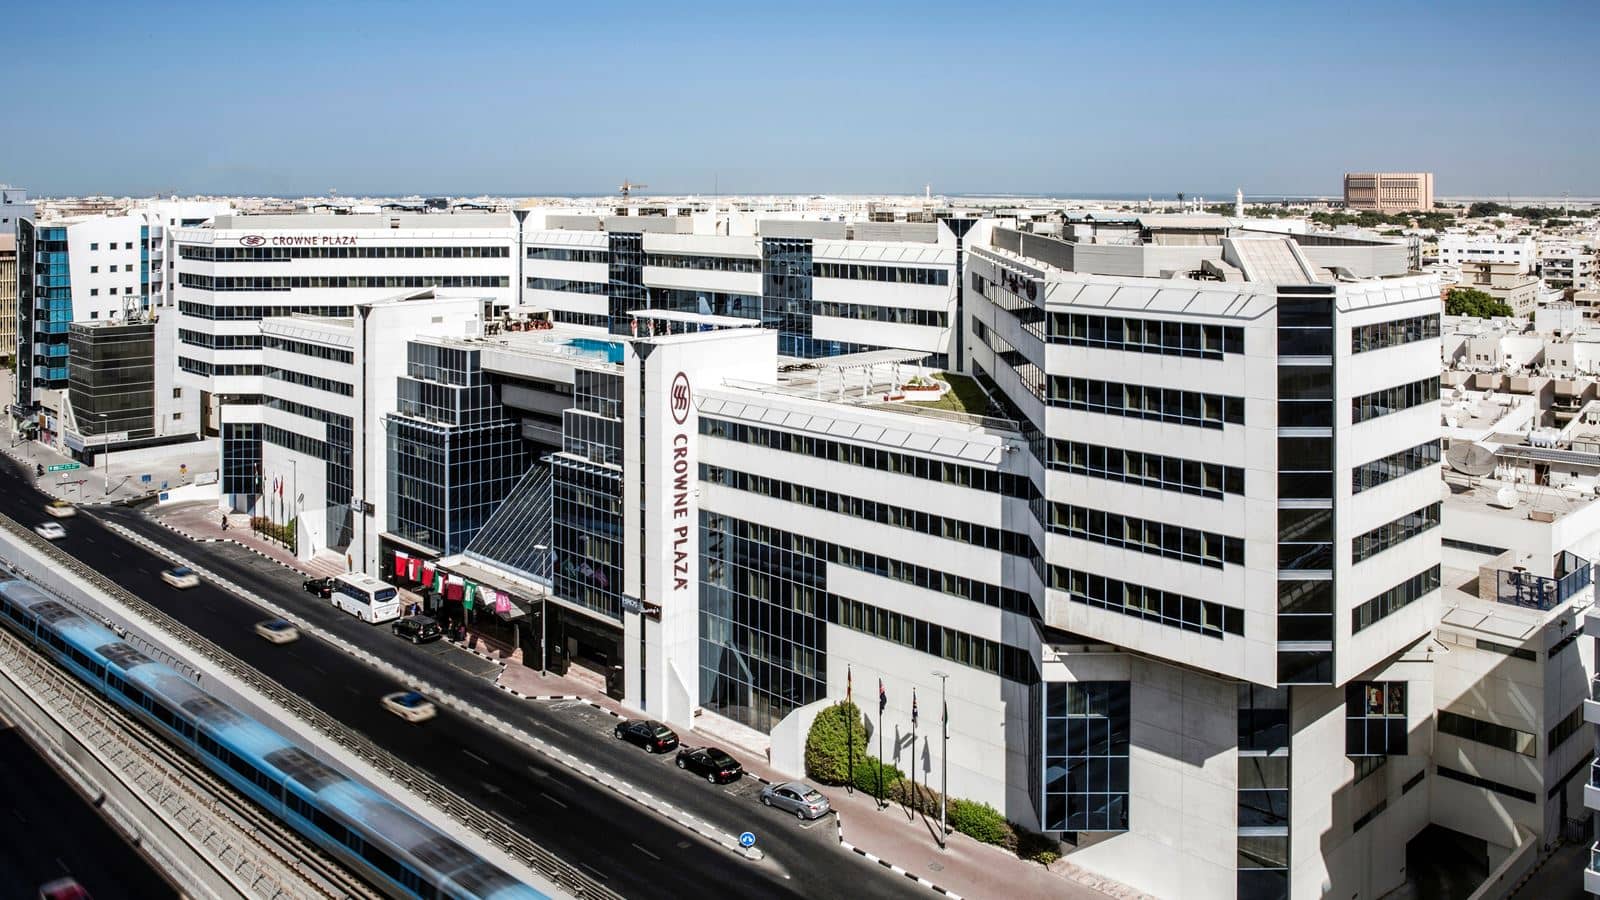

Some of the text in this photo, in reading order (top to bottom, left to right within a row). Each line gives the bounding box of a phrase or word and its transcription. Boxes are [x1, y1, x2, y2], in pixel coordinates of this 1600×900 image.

[272, 236, 357, 246] CROWNE PLAZA
[673, 433, 688, 590] CROWNE PLAZA
